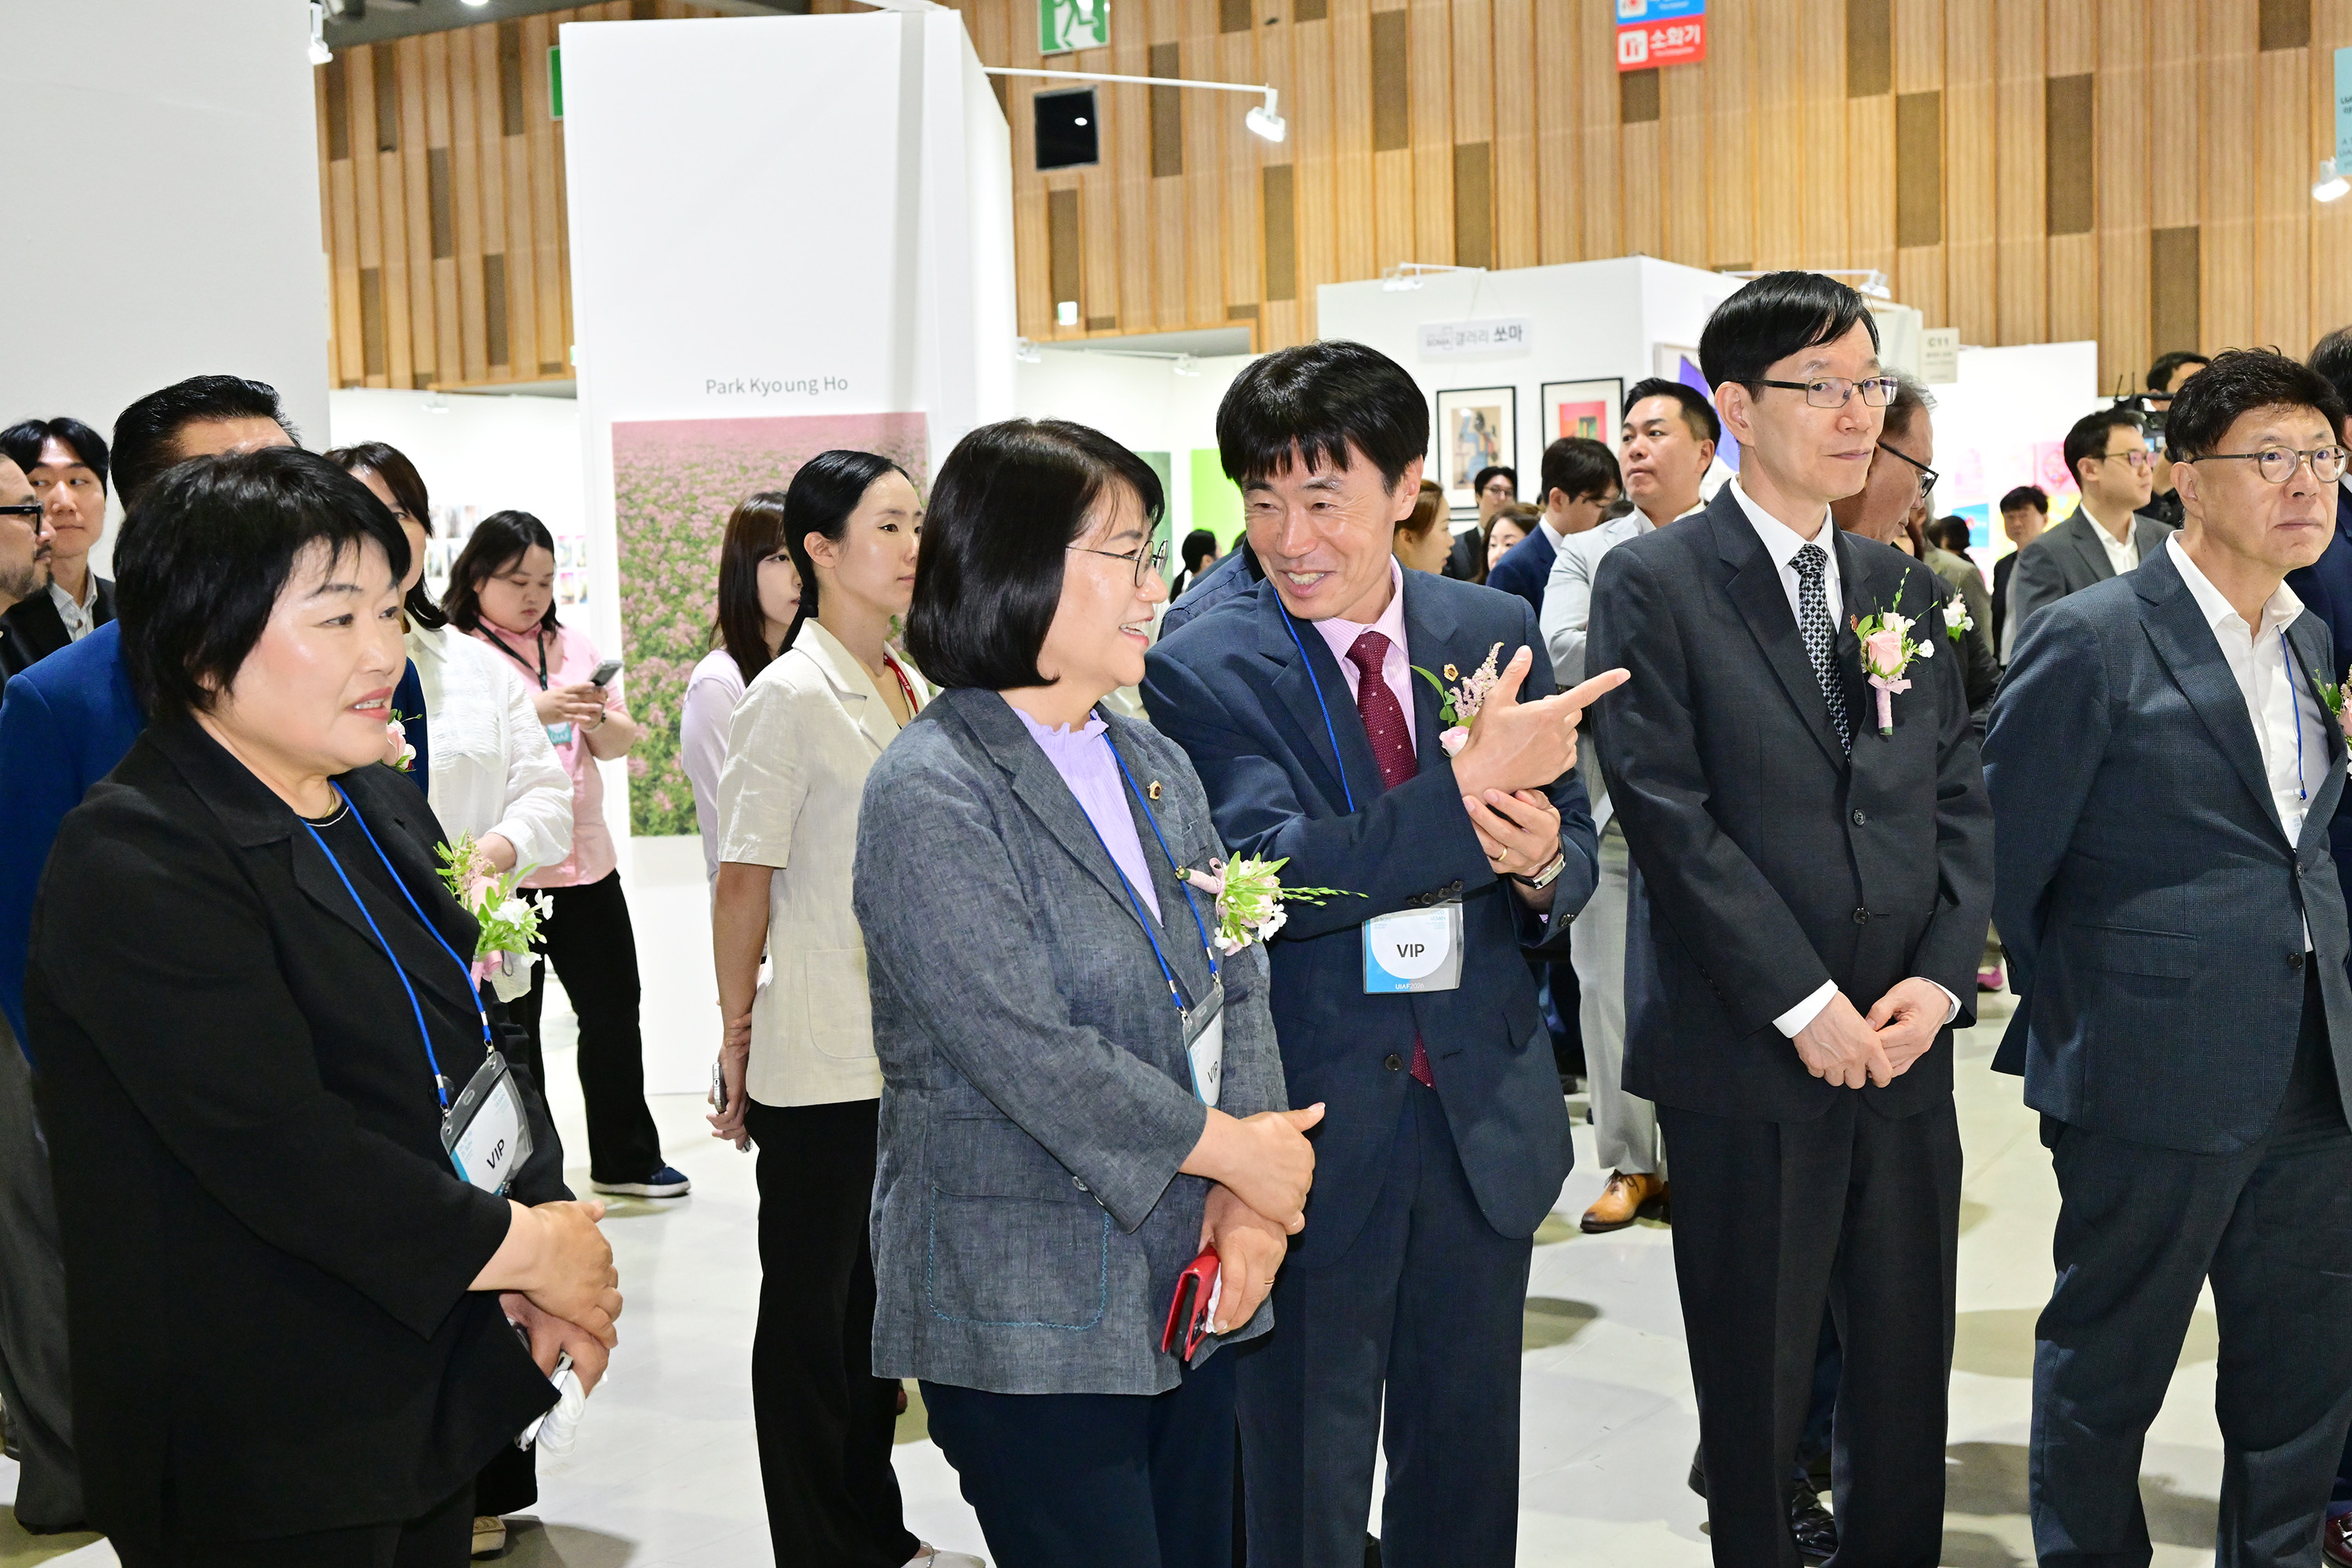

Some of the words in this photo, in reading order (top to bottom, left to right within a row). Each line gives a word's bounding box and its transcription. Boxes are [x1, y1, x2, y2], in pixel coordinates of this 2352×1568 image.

[1650, 24, 1700, 49] 소화기
[1493, 324, 1523, 343] 쏘마
[706, 378, 746, 394] Park
[750, 378, 819, 397] Kyoung
[824, 376, 848, 390] Ho
[1396, 943, 1425, 958] VIP
[1207, 1061, 1219, 1084] VIP
[486, 1138, 505, 1170] VIP
